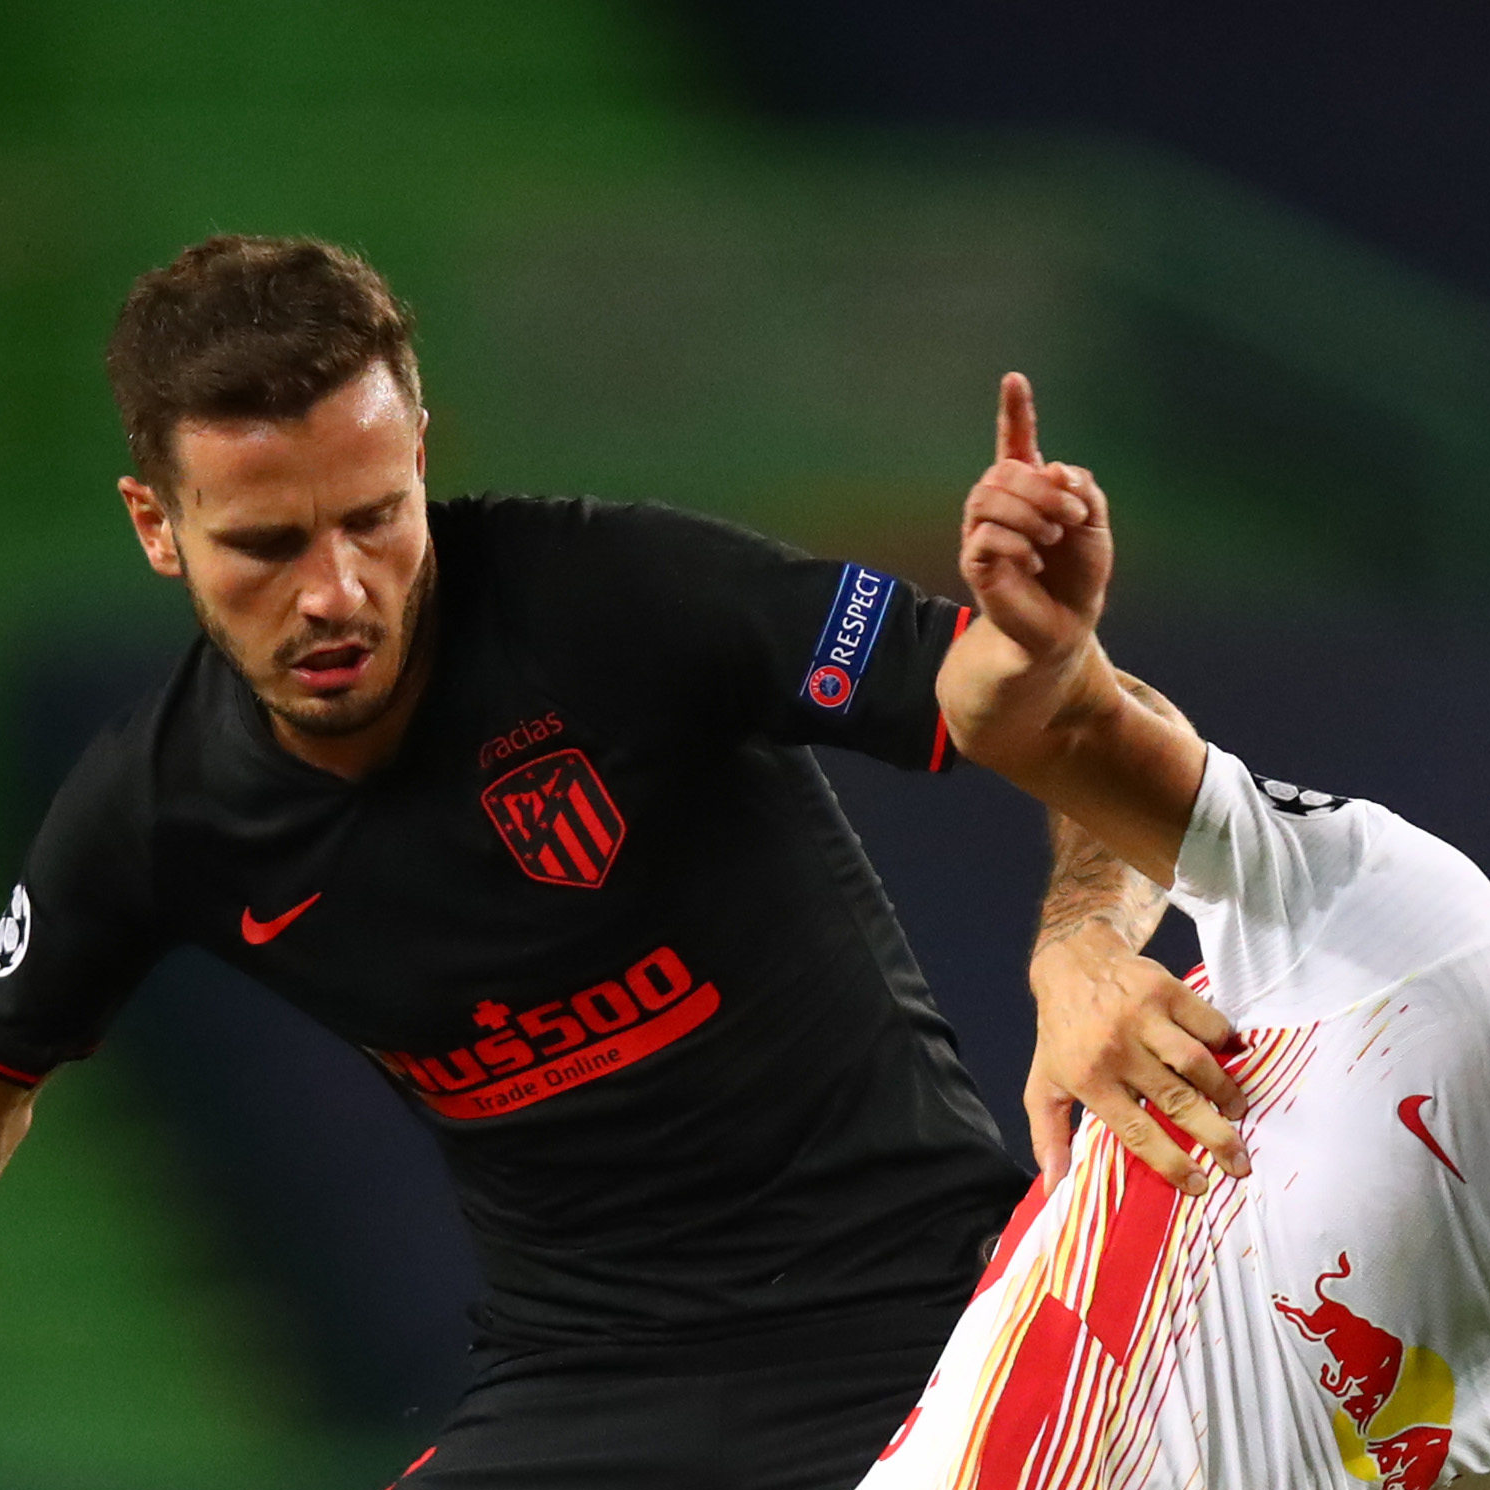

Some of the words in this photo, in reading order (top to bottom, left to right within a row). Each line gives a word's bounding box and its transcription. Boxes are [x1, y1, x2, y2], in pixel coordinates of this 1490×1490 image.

[830, 569, 880, 666] RESPECT
[471, 1081, 538, 1111] Trade
[544, 1048, 621, 1086] Online
